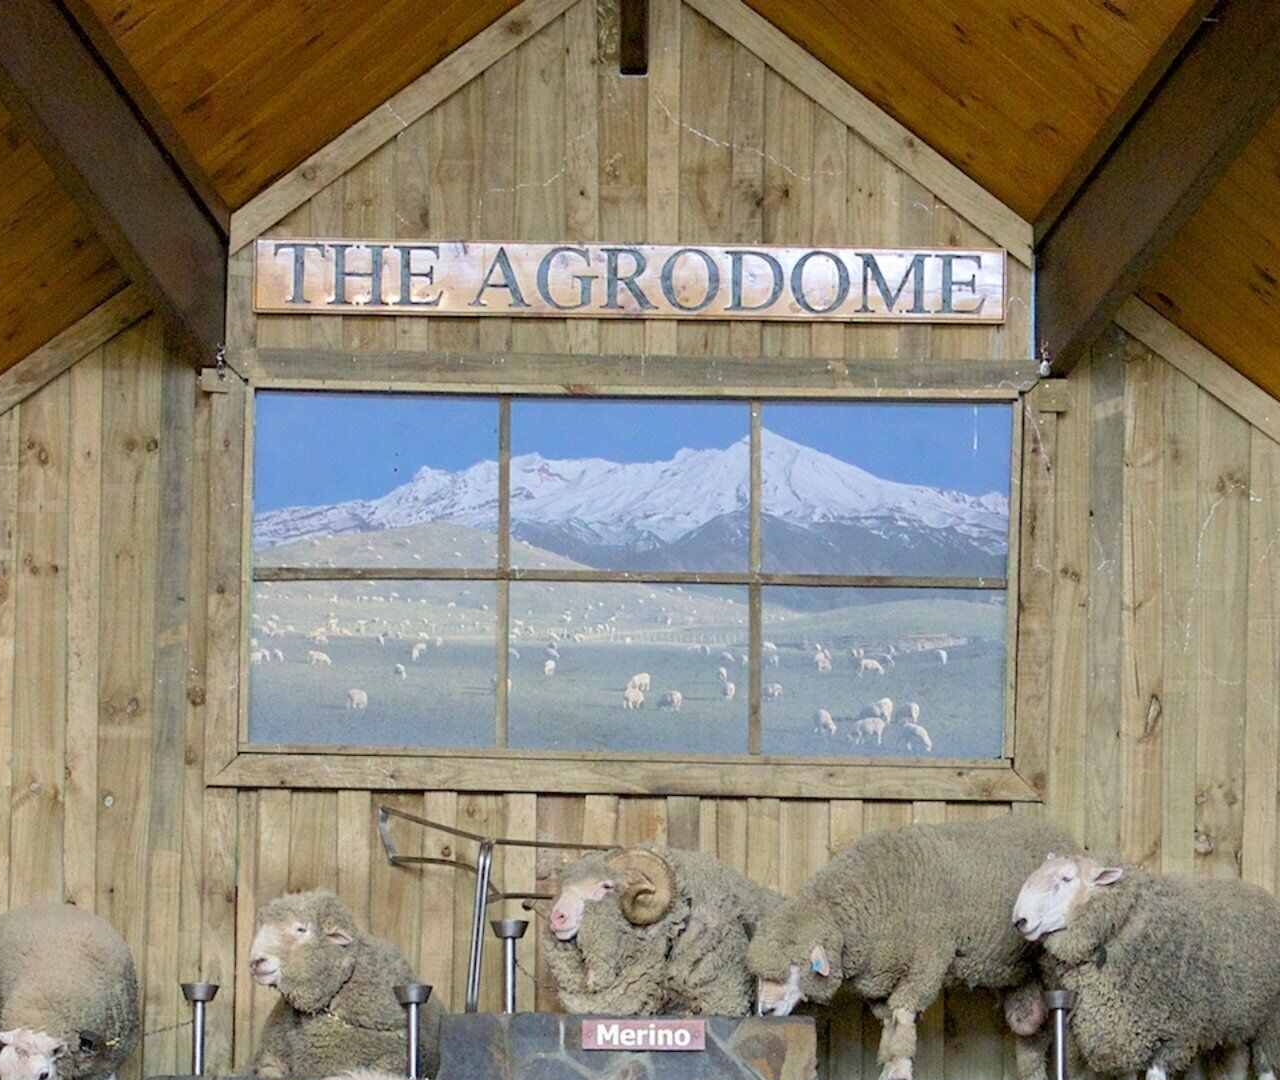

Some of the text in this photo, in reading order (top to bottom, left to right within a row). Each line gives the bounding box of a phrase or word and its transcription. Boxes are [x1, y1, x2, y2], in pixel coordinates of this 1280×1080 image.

[274, 243, 986, 314] THE AGRODOME
[596, 1023, 692, 1047] Merino
